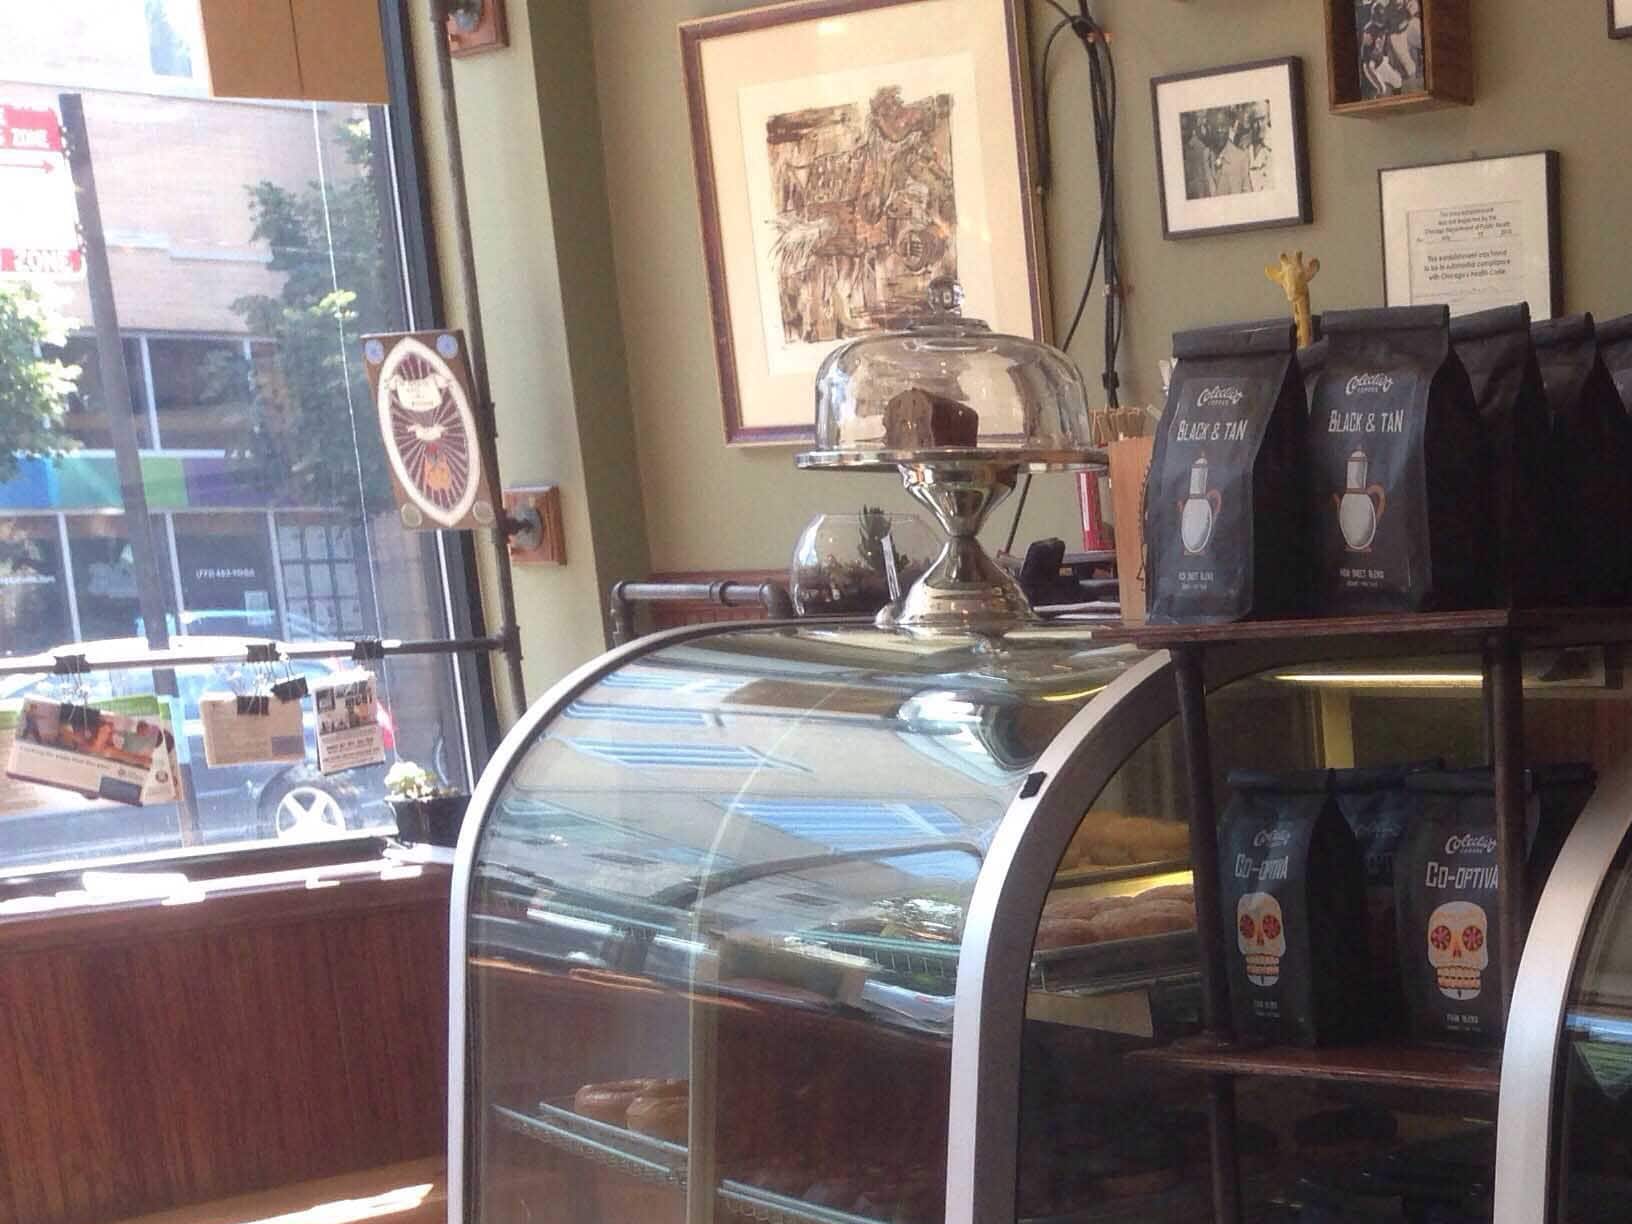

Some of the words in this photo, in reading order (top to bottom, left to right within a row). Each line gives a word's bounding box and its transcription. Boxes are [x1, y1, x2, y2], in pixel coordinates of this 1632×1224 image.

[1176, 420, 1209, 441] BLACK
[1211, 422, 1221, 441] &
[1223, 420, 1249, 441] TAN
[1328, 410, 1363, 432] BLACK
[1365, 413, 1376, 432] &
[1381, 409, 1404, 432] TAN
